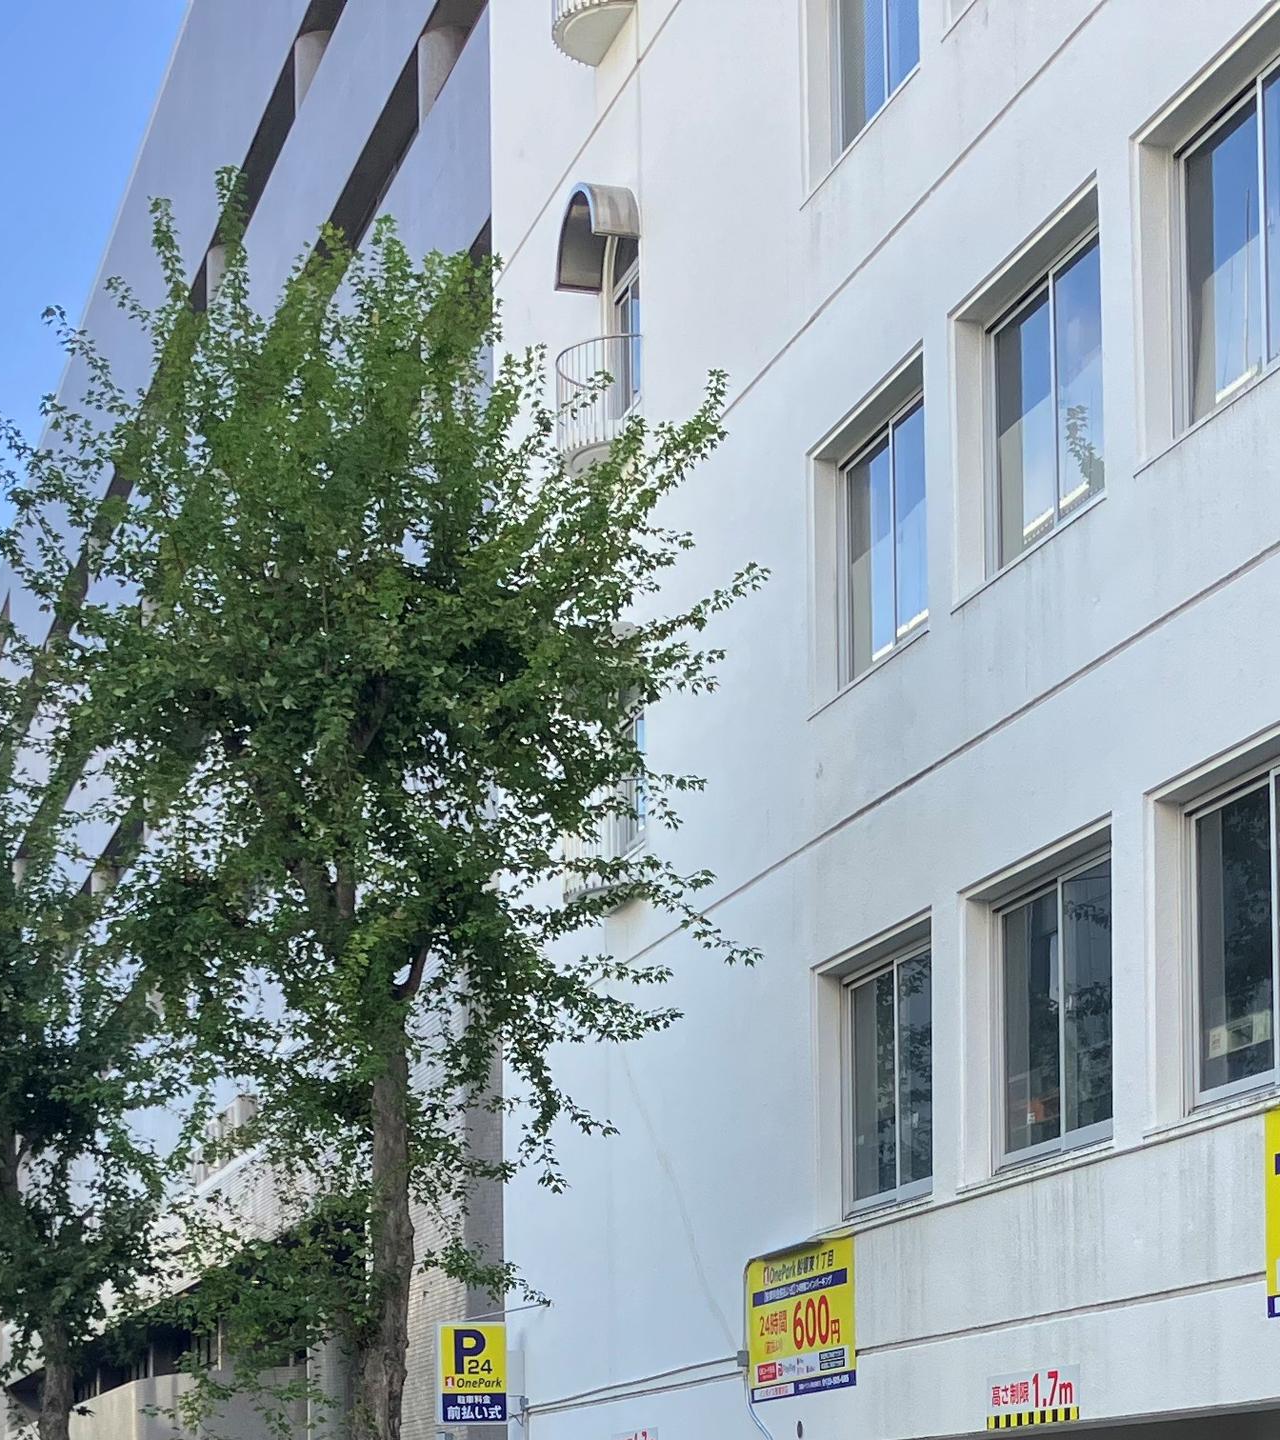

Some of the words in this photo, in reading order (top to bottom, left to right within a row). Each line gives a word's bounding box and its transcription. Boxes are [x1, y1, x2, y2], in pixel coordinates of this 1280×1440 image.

[793, 1295, 840, 1350] 600円
[454, 1329, 486, 1375] P
[468, 1359, 493, 1375] 24
[456, 1377, 503, 1389] OnePark
[991, 1381, 1029, 1407] 高さ制限
[1032, 1370, 1073, 1408] 1.7m
[446, 1405, 502, 1420] 前払い式
